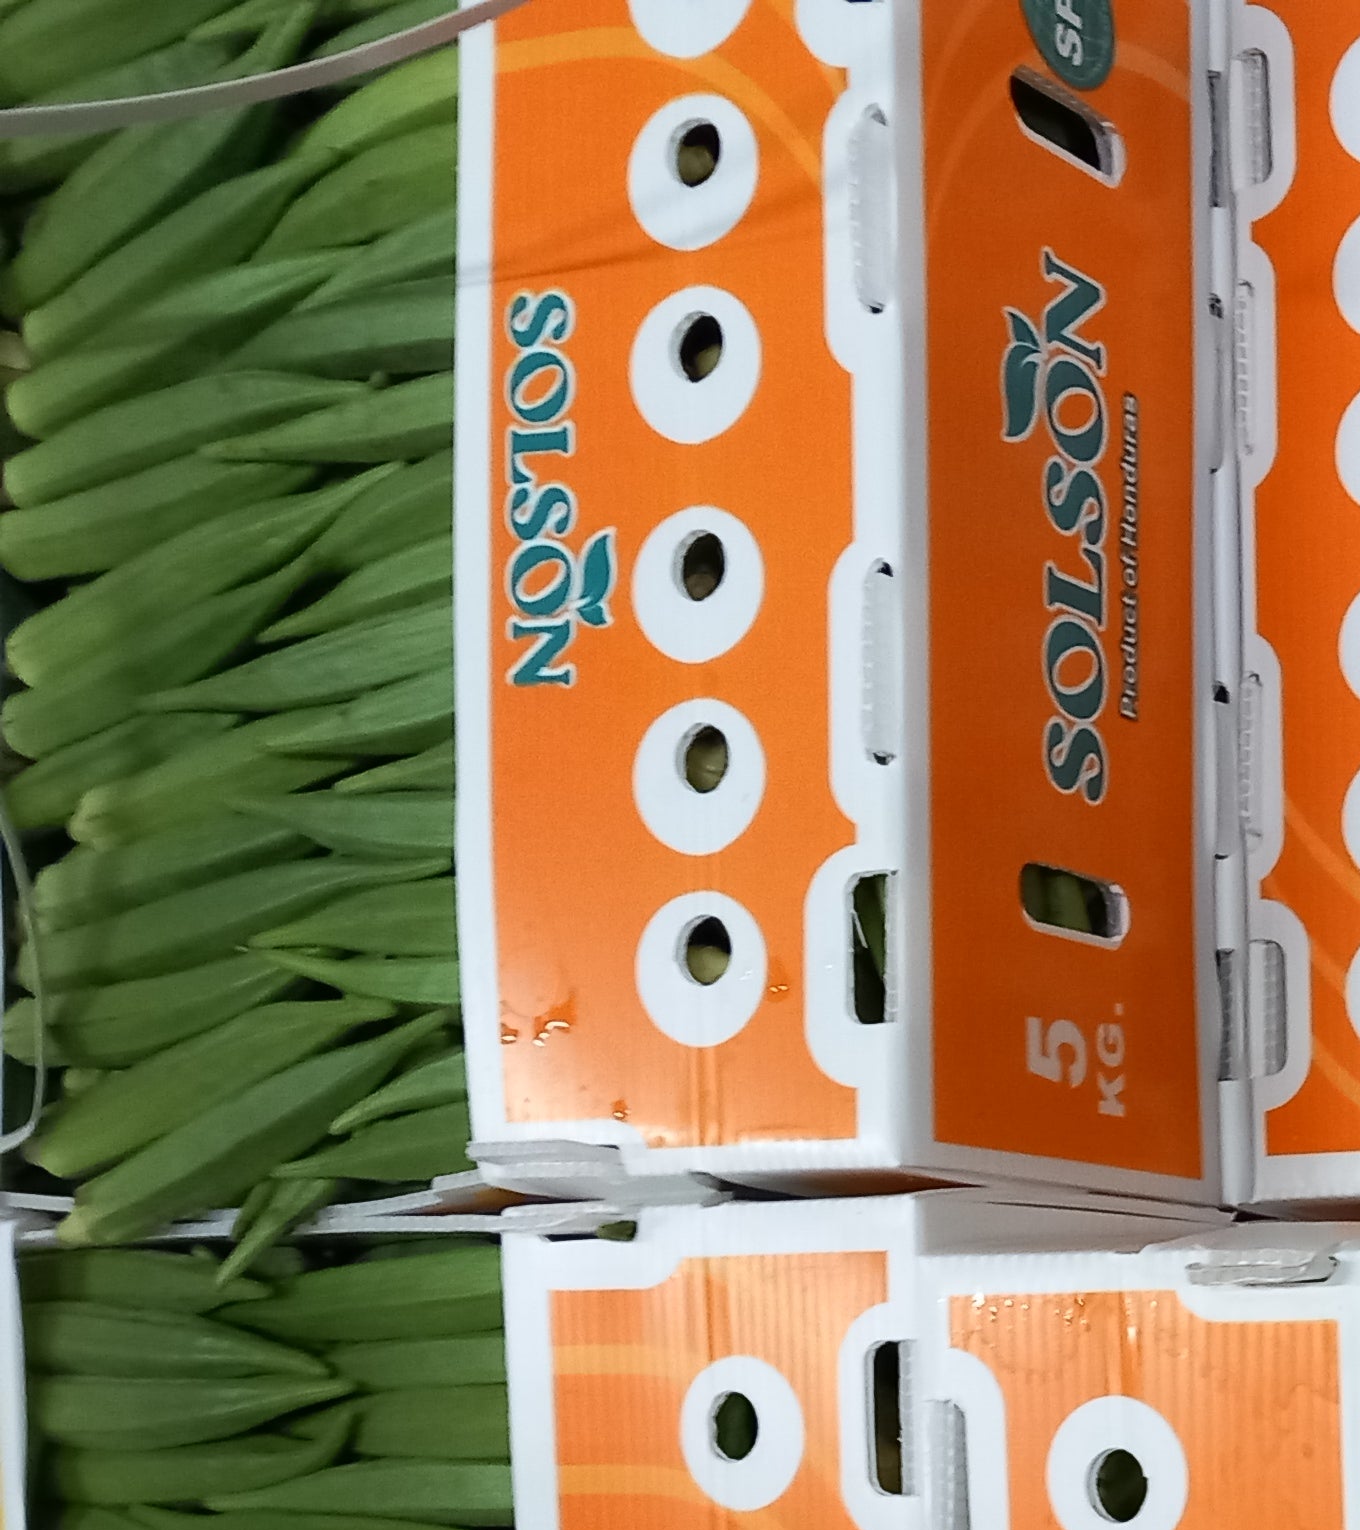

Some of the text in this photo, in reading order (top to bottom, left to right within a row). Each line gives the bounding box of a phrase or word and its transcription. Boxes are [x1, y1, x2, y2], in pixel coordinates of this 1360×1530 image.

[509, 291, 574, 687] SOLSON
[1045, 248, 1108, 803] SOLSON
[1118, 391, 1138, 720] Product of Honduras
[1026, 1016, 1087, 1089] 5
